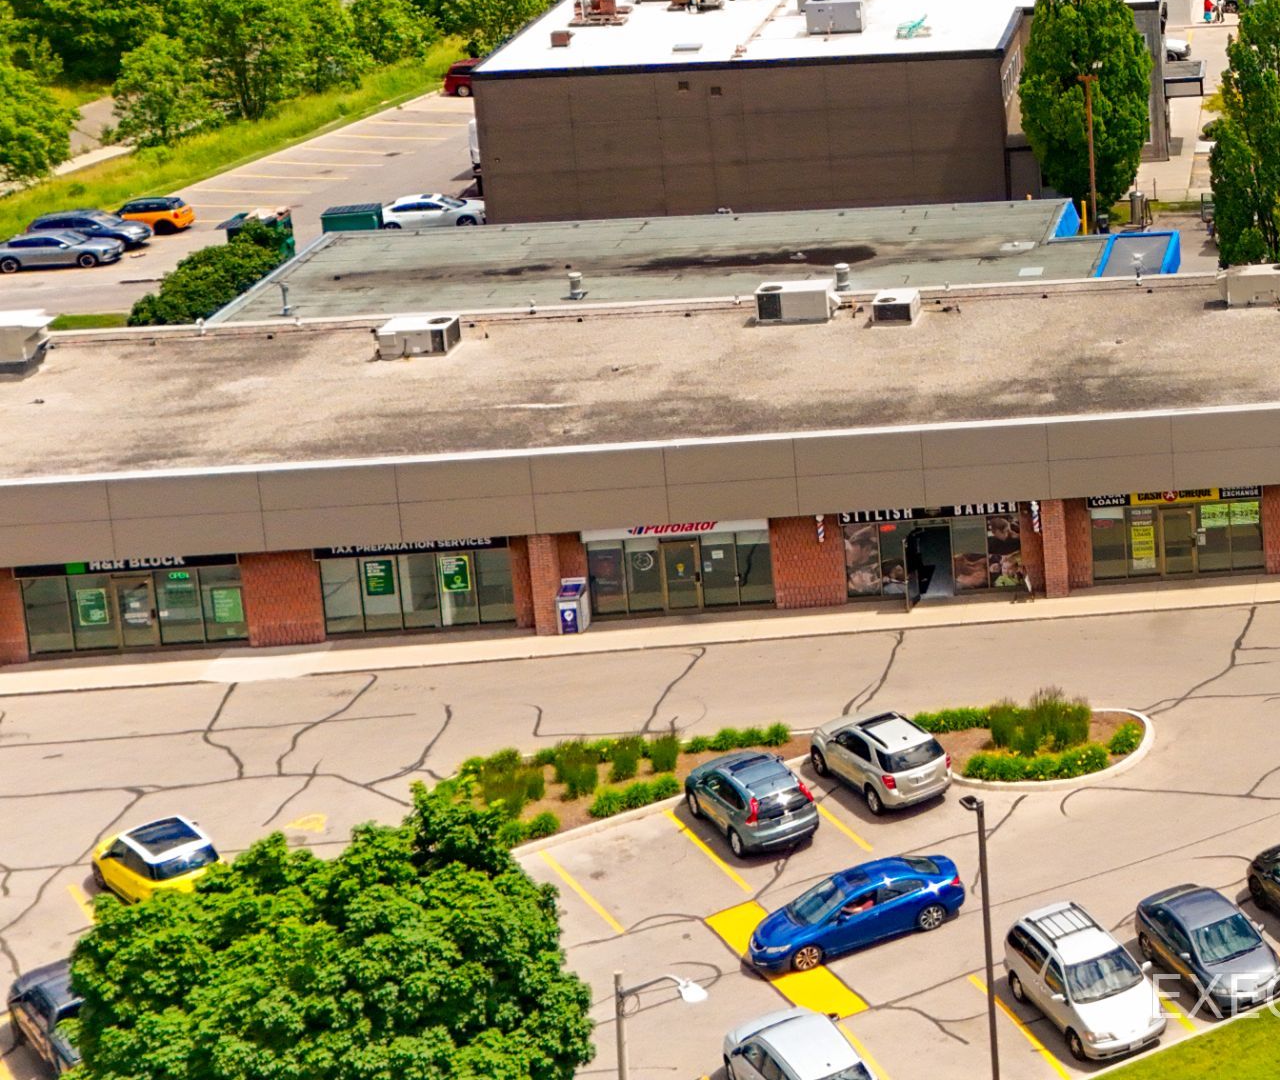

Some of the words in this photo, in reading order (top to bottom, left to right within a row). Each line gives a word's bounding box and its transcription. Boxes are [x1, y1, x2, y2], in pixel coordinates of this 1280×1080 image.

[1138, 492, 1162, 501] CASH
[1166, 490, 1176, 499] A
[1222, 490, 1259, 498] EXCHANGE
[1092, 497, 1126, 507] LOANS
[842, 508, 913, 523] STYLISH
[954, 502, 1017, 516] BARBER
[330, 545, 353, 554] TAX
[356, 540, 436, 553] PREPARATION
[438, 537, 492, 548] SERVICES
[89, 560, 125, 571] H&R
[129, 556, 186, 569] BLOCK
